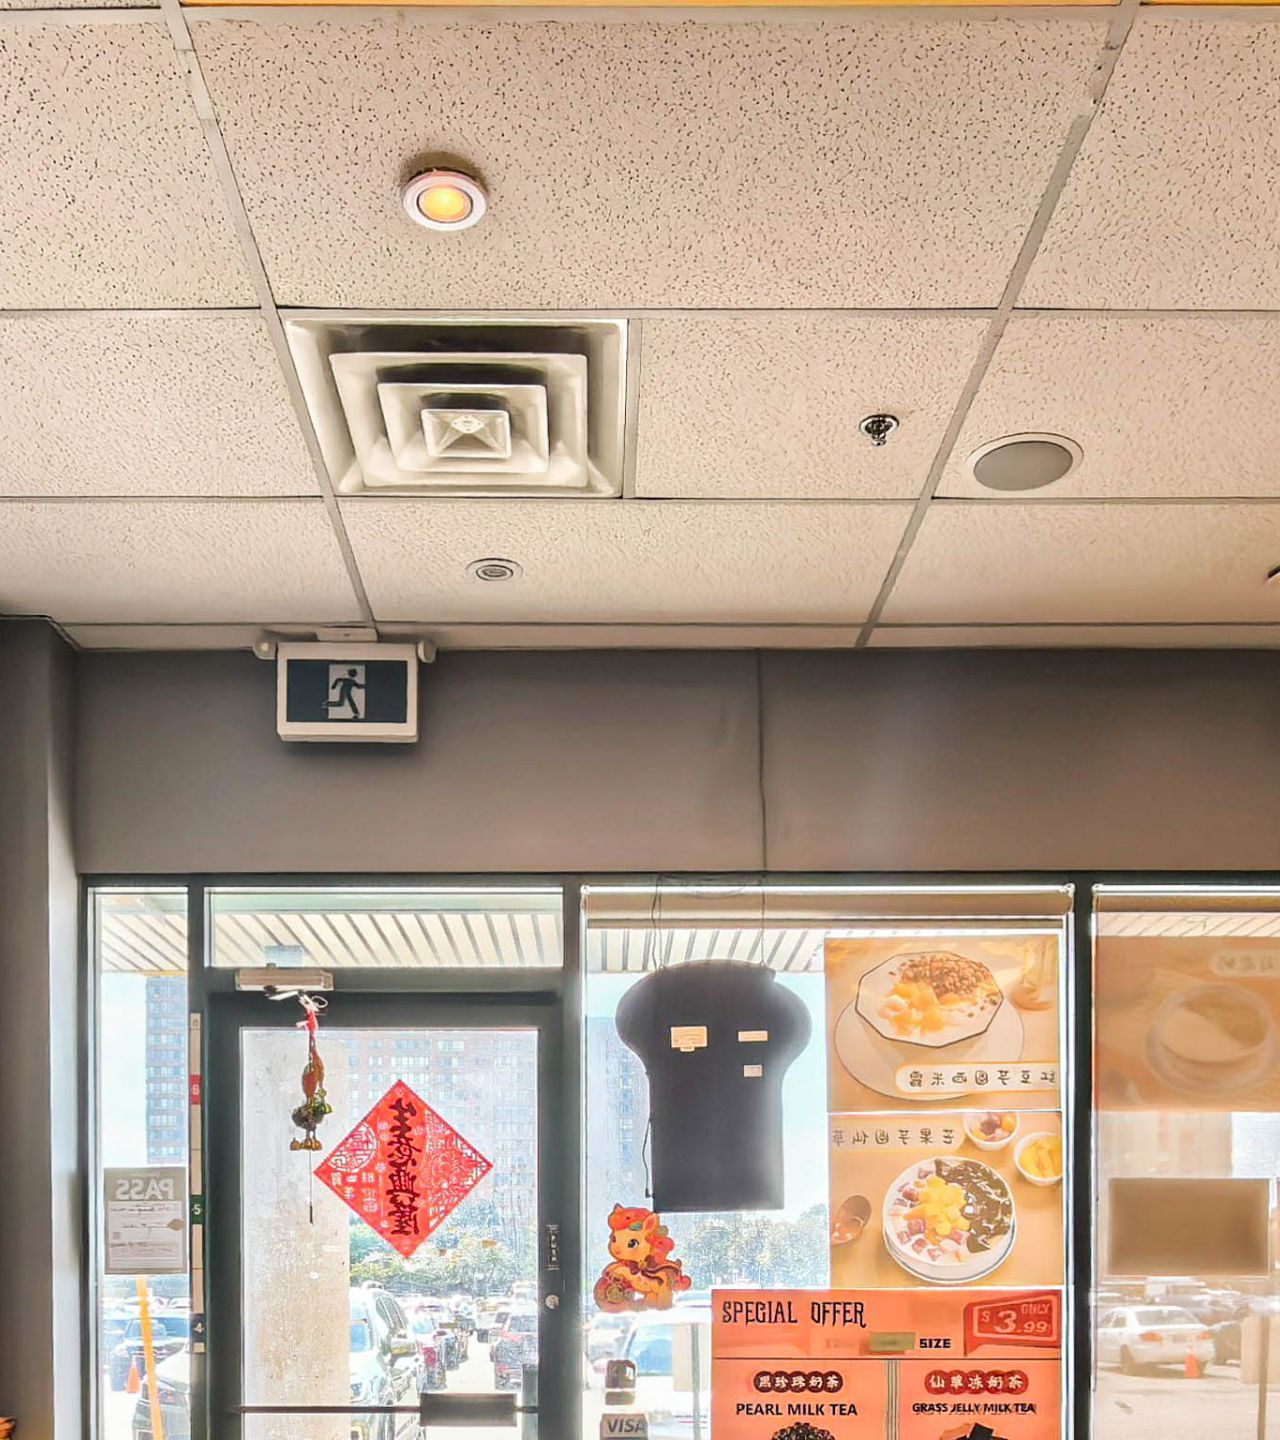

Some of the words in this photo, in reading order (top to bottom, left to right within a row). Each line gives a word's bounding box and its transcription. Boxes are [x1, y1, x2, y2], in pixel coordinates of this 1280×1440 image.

[722, 1300, 798, 1326] SPECIAL
[810, 1301, 867, 1329] OFFER
[919, 1338, 952, 1349] SIZE
[736, 1403, 783, 1416] PEARL
[787, 1403, 825, 1416] MILK
[828, 1403, 858, 1416] TEA
[912, 1402, 949, 1414] GRASS
[950, 1402, 981, 1414] JELLY
[983, 1402, 1011, 1414] MILK
[1014, 1402, 1037, 1414] TEA
[607, 1418, 647, 1434] VISA
